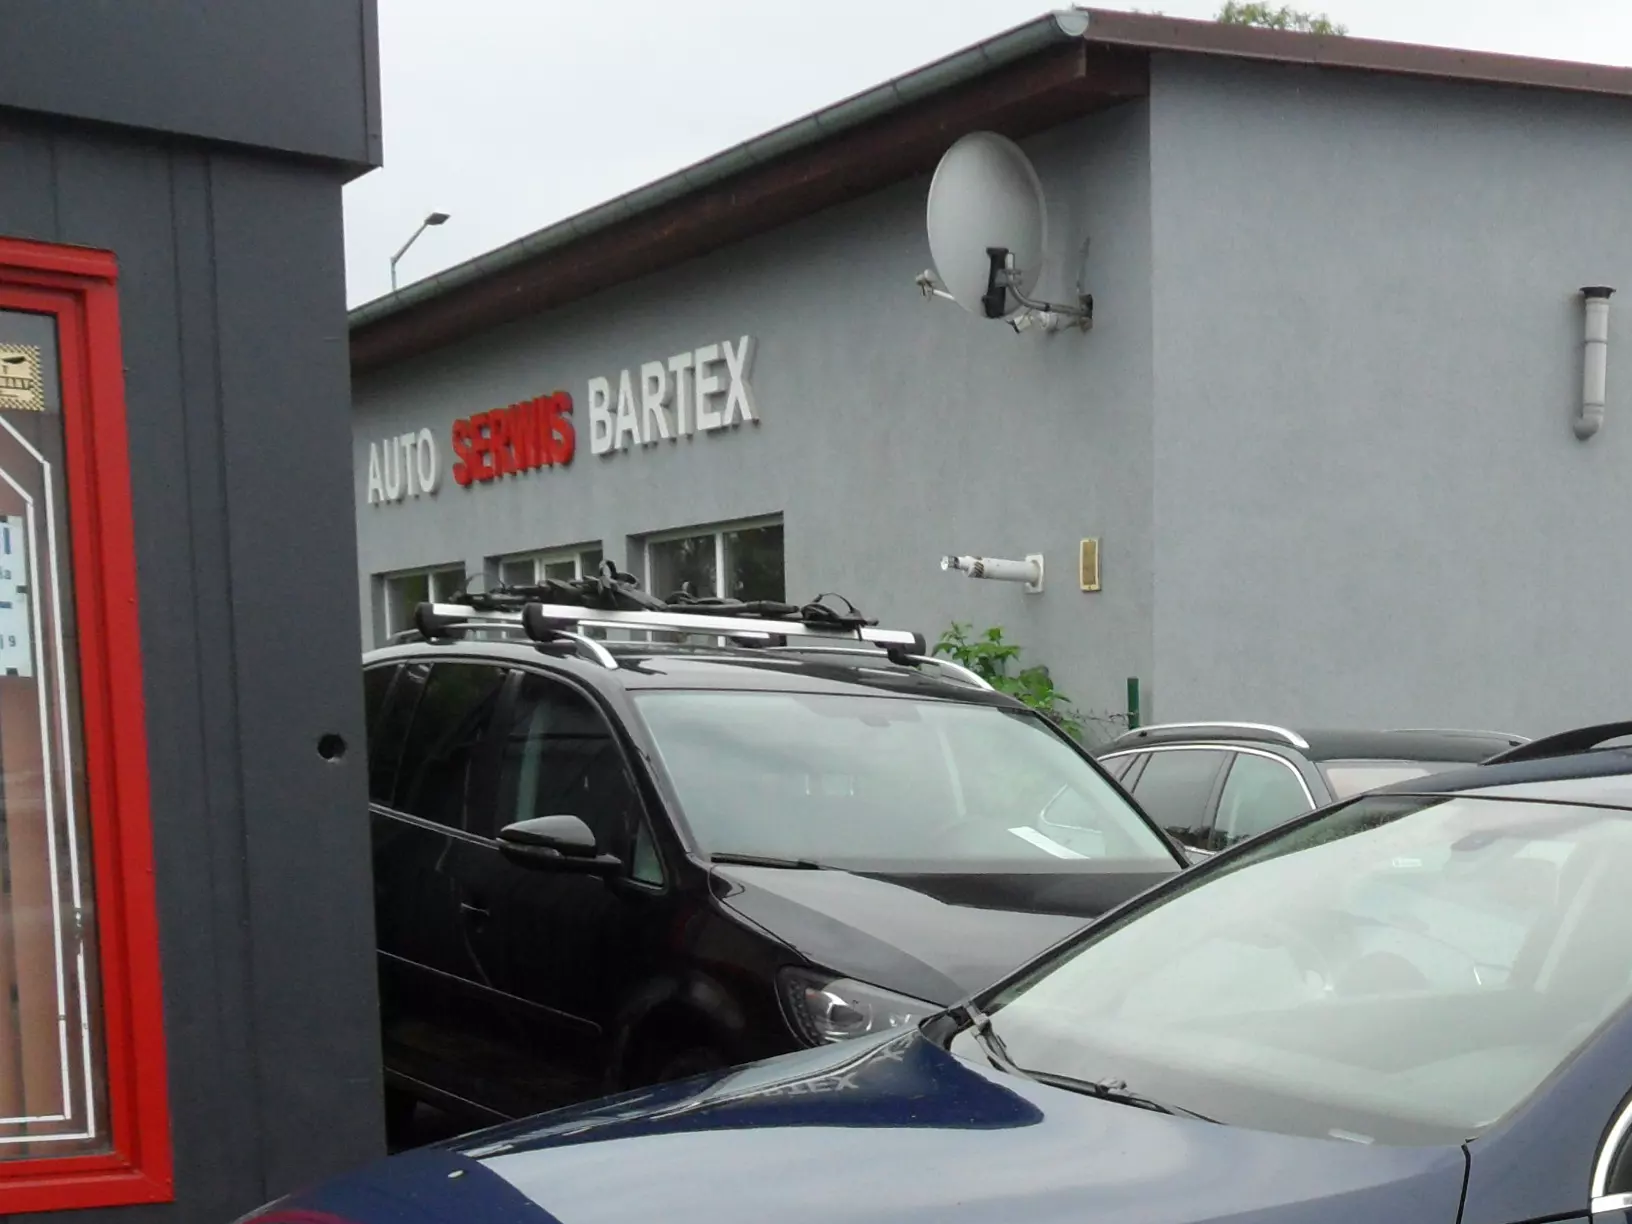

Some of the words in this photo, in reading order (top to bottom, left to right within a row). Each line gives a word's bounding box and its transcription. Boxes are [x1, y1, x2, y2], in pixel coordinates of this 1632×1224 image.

[368, 427, 440, 504] AUTO
[451, 390, 576, 487] SERWIS
[588, 334, 757, 456] BARTEX
